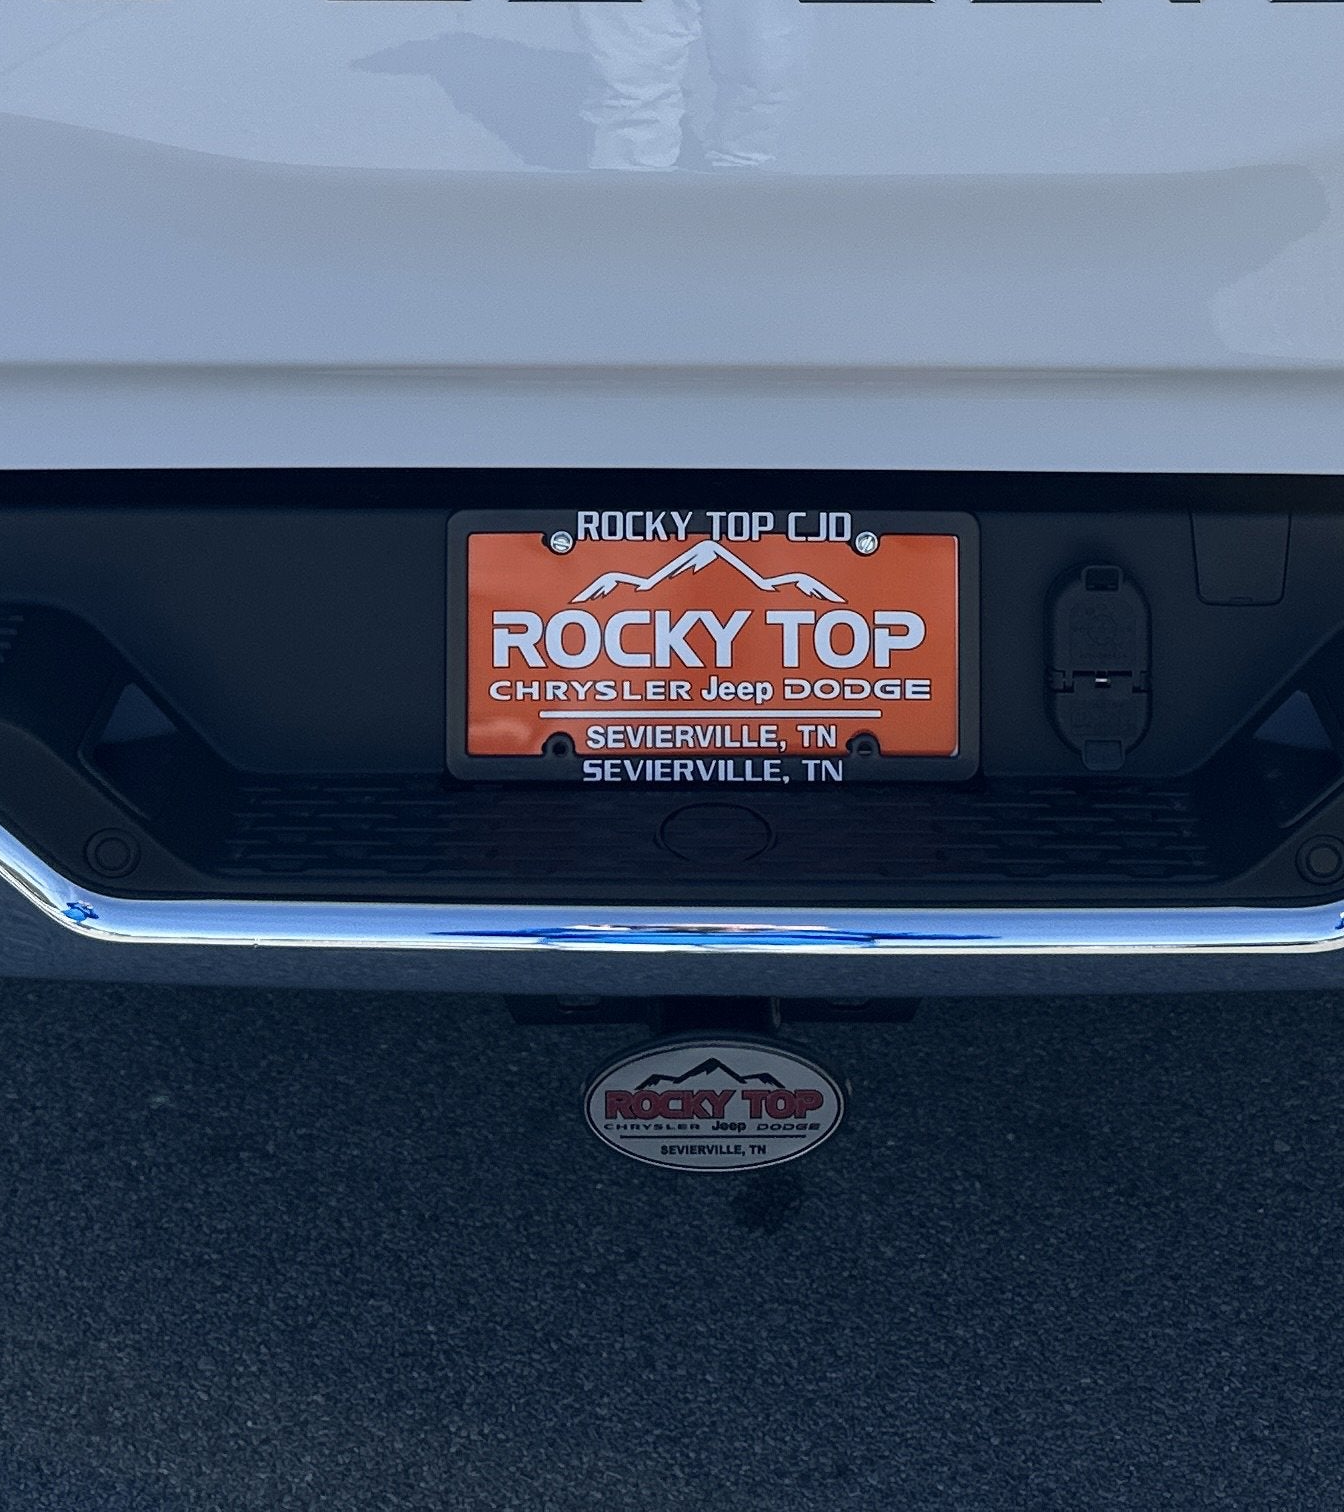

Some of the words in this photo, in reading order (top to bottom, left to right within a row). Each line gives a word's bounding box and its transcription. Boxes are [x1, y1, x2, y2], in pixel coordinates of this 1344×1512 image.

[576, 510, 693, 542] ROCKY
[705, 511, 775, 542] TOP
[787, 511, 852, 543] CJD
[491, 609, 753, 669] ROCKY
[764, 609, 927, 669] TOP
[488, 679, 691, 702] CHRYSLER
[701, 676, 775, 705] Jeep
[783, 678, 932, 702] DODGE
[585, 724, 788, 752] SEVIERVILLE,
[796, 724, 837, 749] TN
[582, 759, 790, 785] SEVIERVILLE,
[800, 759, 844, 782] TN
[604, 1089, 736, 1120] ROCKY
[742, 1089, 824, 1120] TOP
[603, 1122, 701, 1130] CHRYSLER
[711, 1120, 747, 1133] Jeep
[756, 1122, 821, 1130] DODGE
[660, 1144, 746, 1157] SEVIERVILLE,
[749, 1144, 767, 1155] TN
